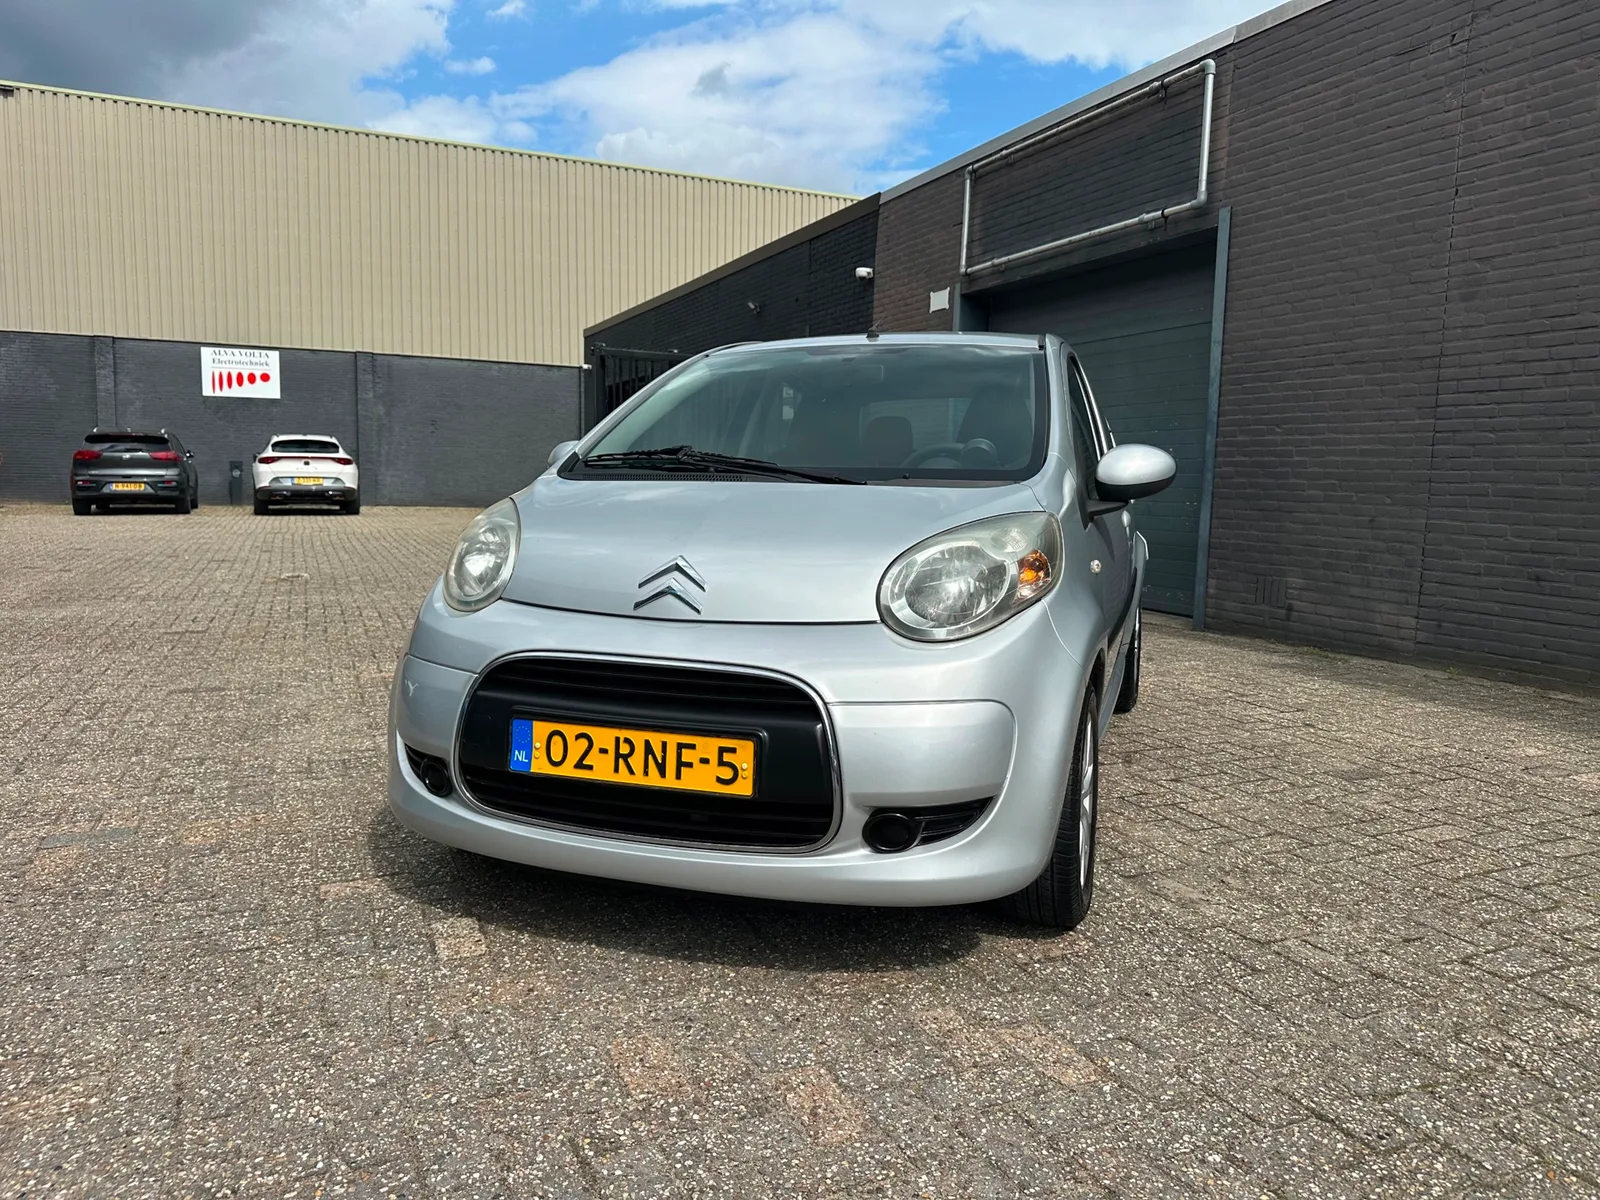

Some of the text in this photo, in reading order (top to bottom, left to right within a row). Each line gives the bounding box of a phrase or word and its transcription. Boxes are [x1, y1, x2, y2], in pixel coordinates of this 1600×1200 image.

[211, 349, 270, 359] ALVA VOLTA
[212, 357, 270, 367] Electrotechniek
[514, 749, 529, 763] NL
[545, 729, 740, 786] 02-RNF-5
